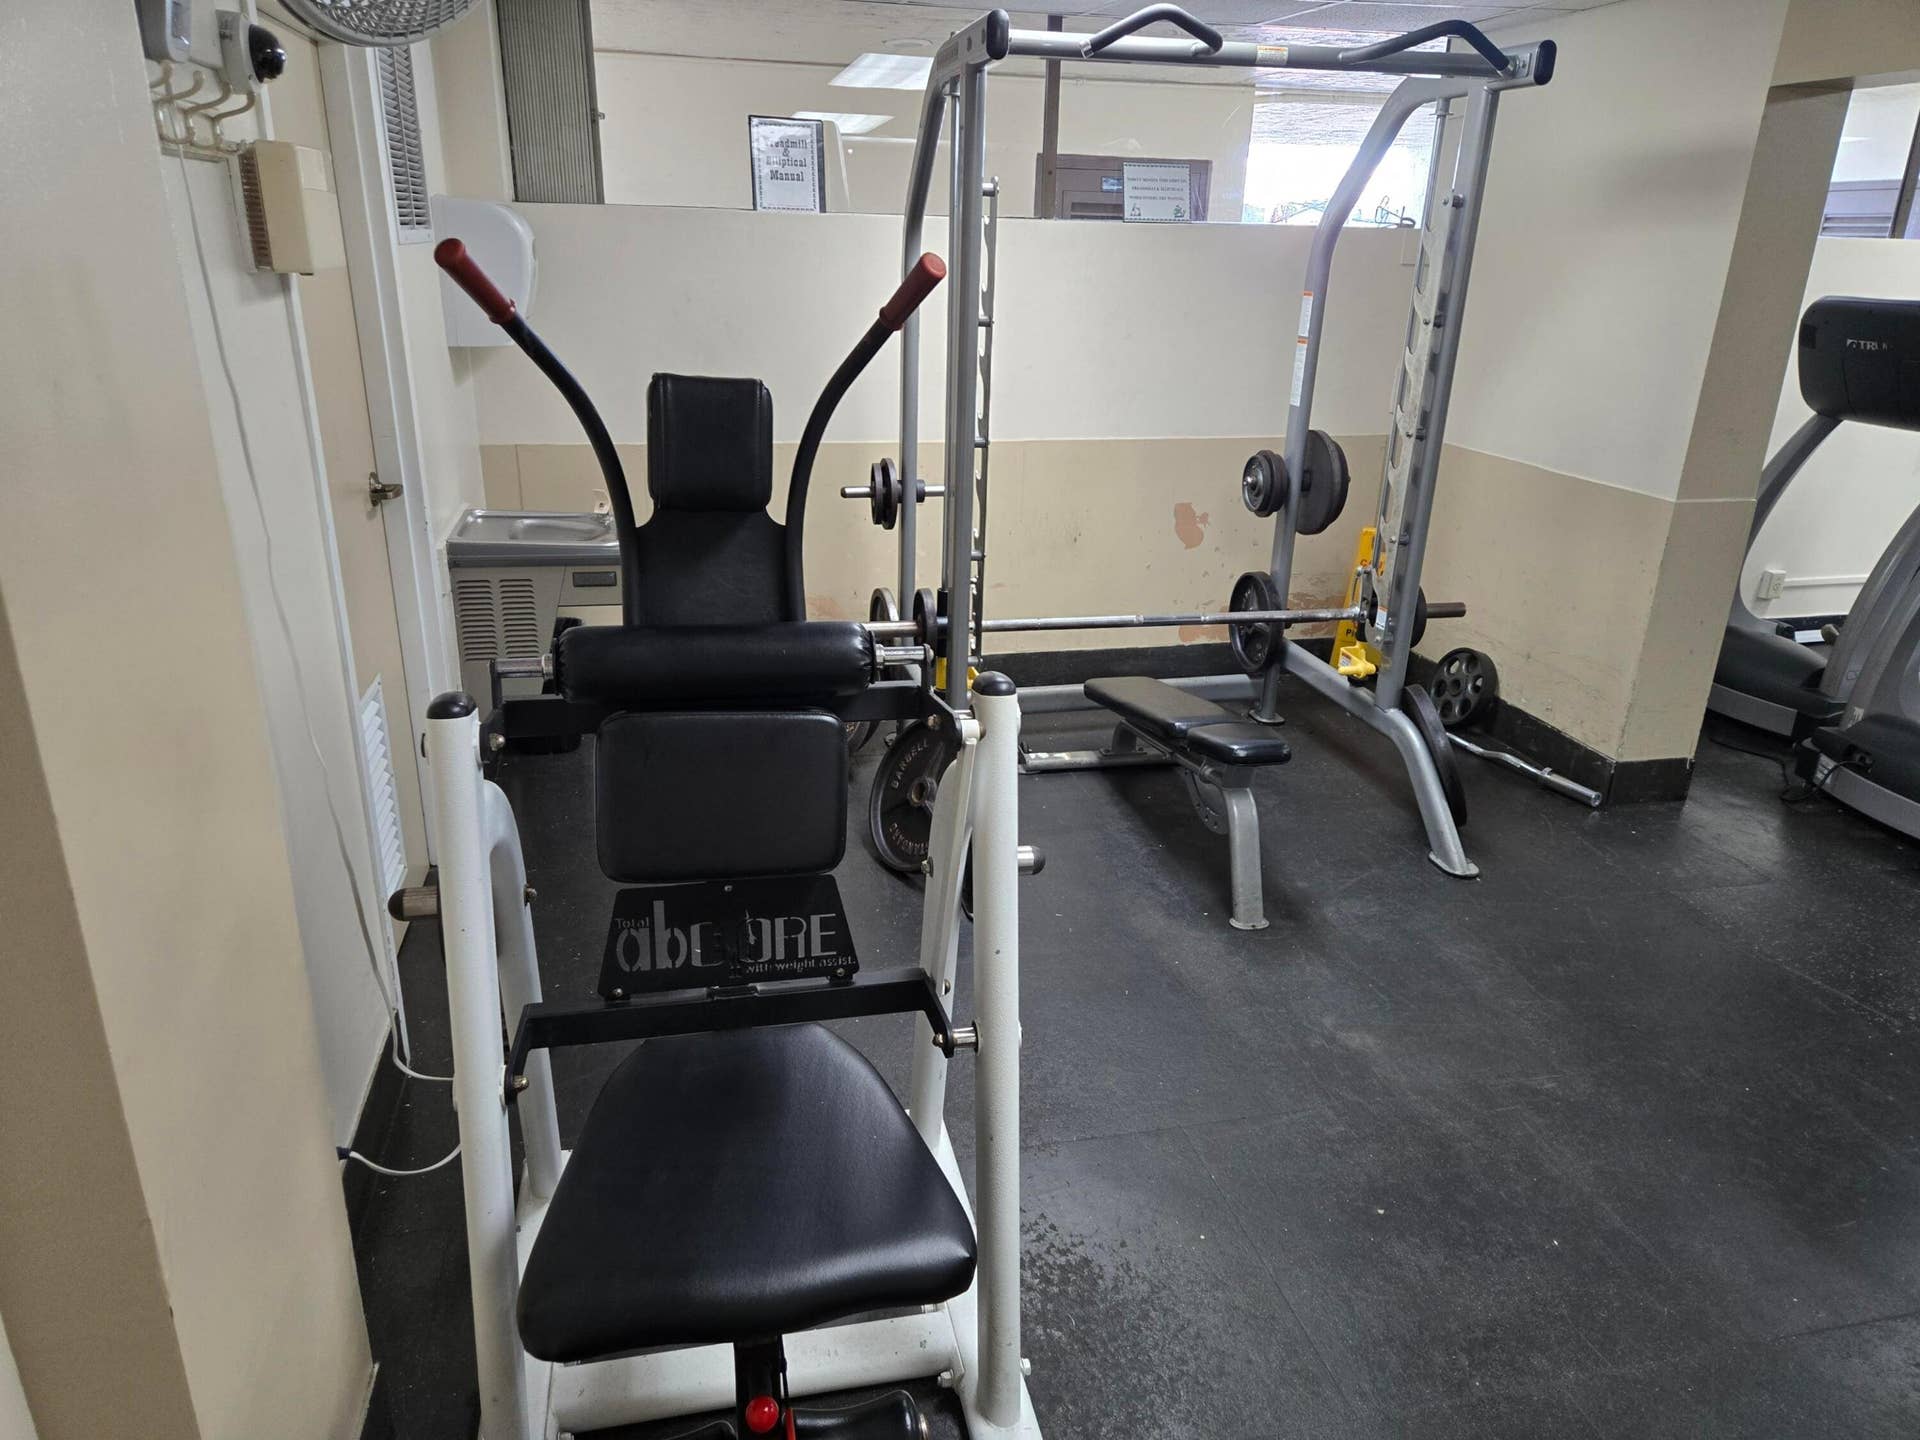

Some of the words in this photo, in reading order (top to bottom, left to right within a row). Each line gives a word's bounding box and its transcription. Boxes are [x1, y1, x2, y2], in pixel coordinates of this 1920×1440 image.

[782, 148, 790, 158] &
[770, 169, 805, 182] Manual
[614, 916, 650, 930] Total
[746, 962, 772, 975] with
[775, 957, 816, 974] weight
